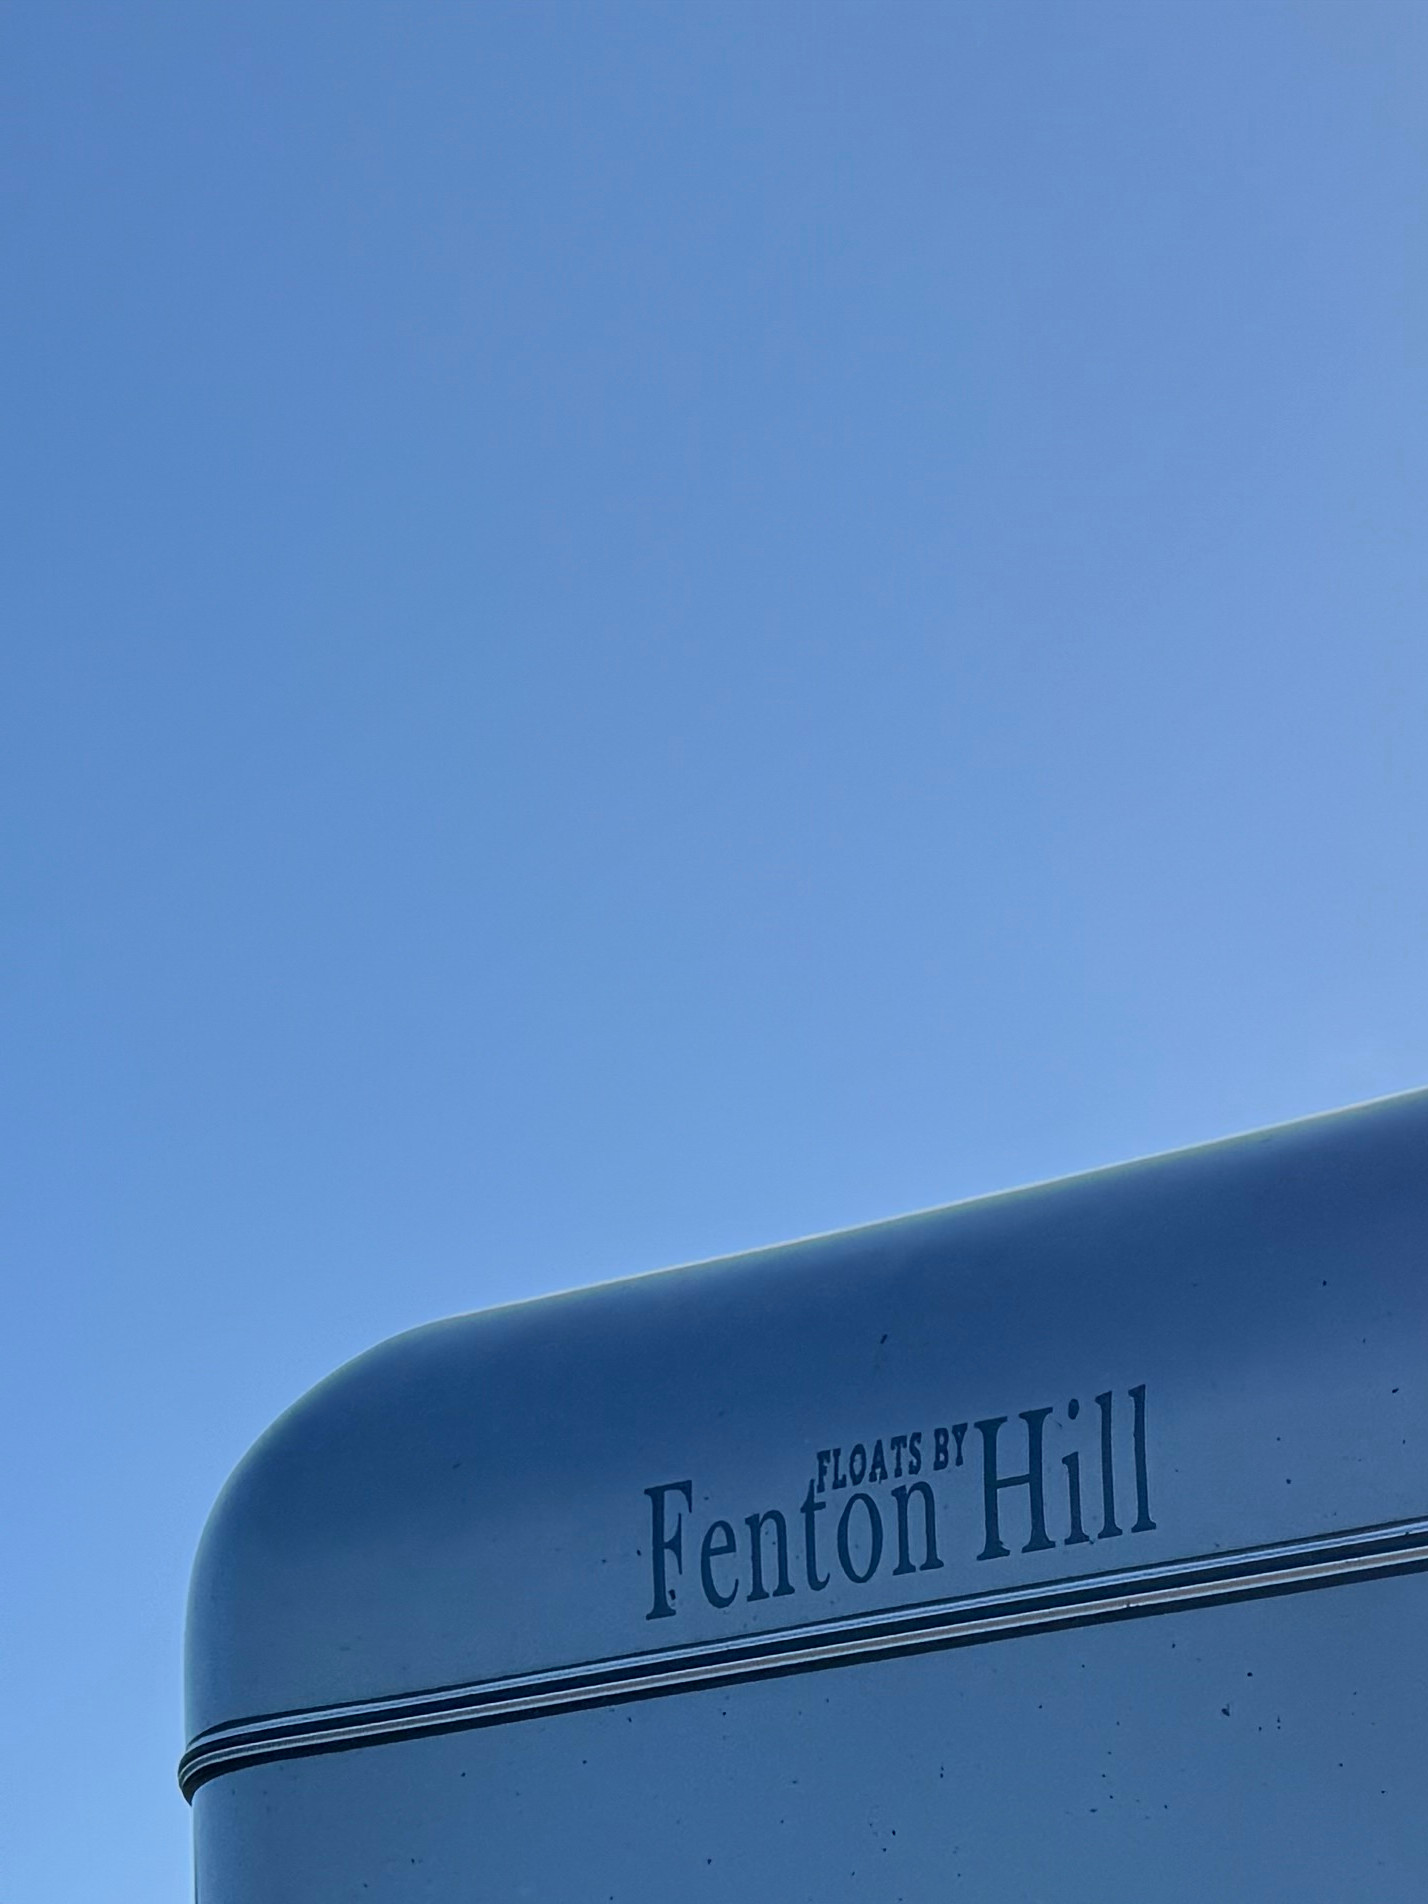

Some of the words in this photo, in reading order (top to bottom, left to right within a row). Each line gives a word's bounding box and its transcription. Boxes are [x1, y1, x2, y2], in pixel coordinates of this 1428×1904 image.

[644, 1479, 944, 1620] Fenton
[974, 1384, 1157, 1561] Hill
[816, 1432, 923, 1493] FLOATS
[933, 1422, 968, 1471] BY
